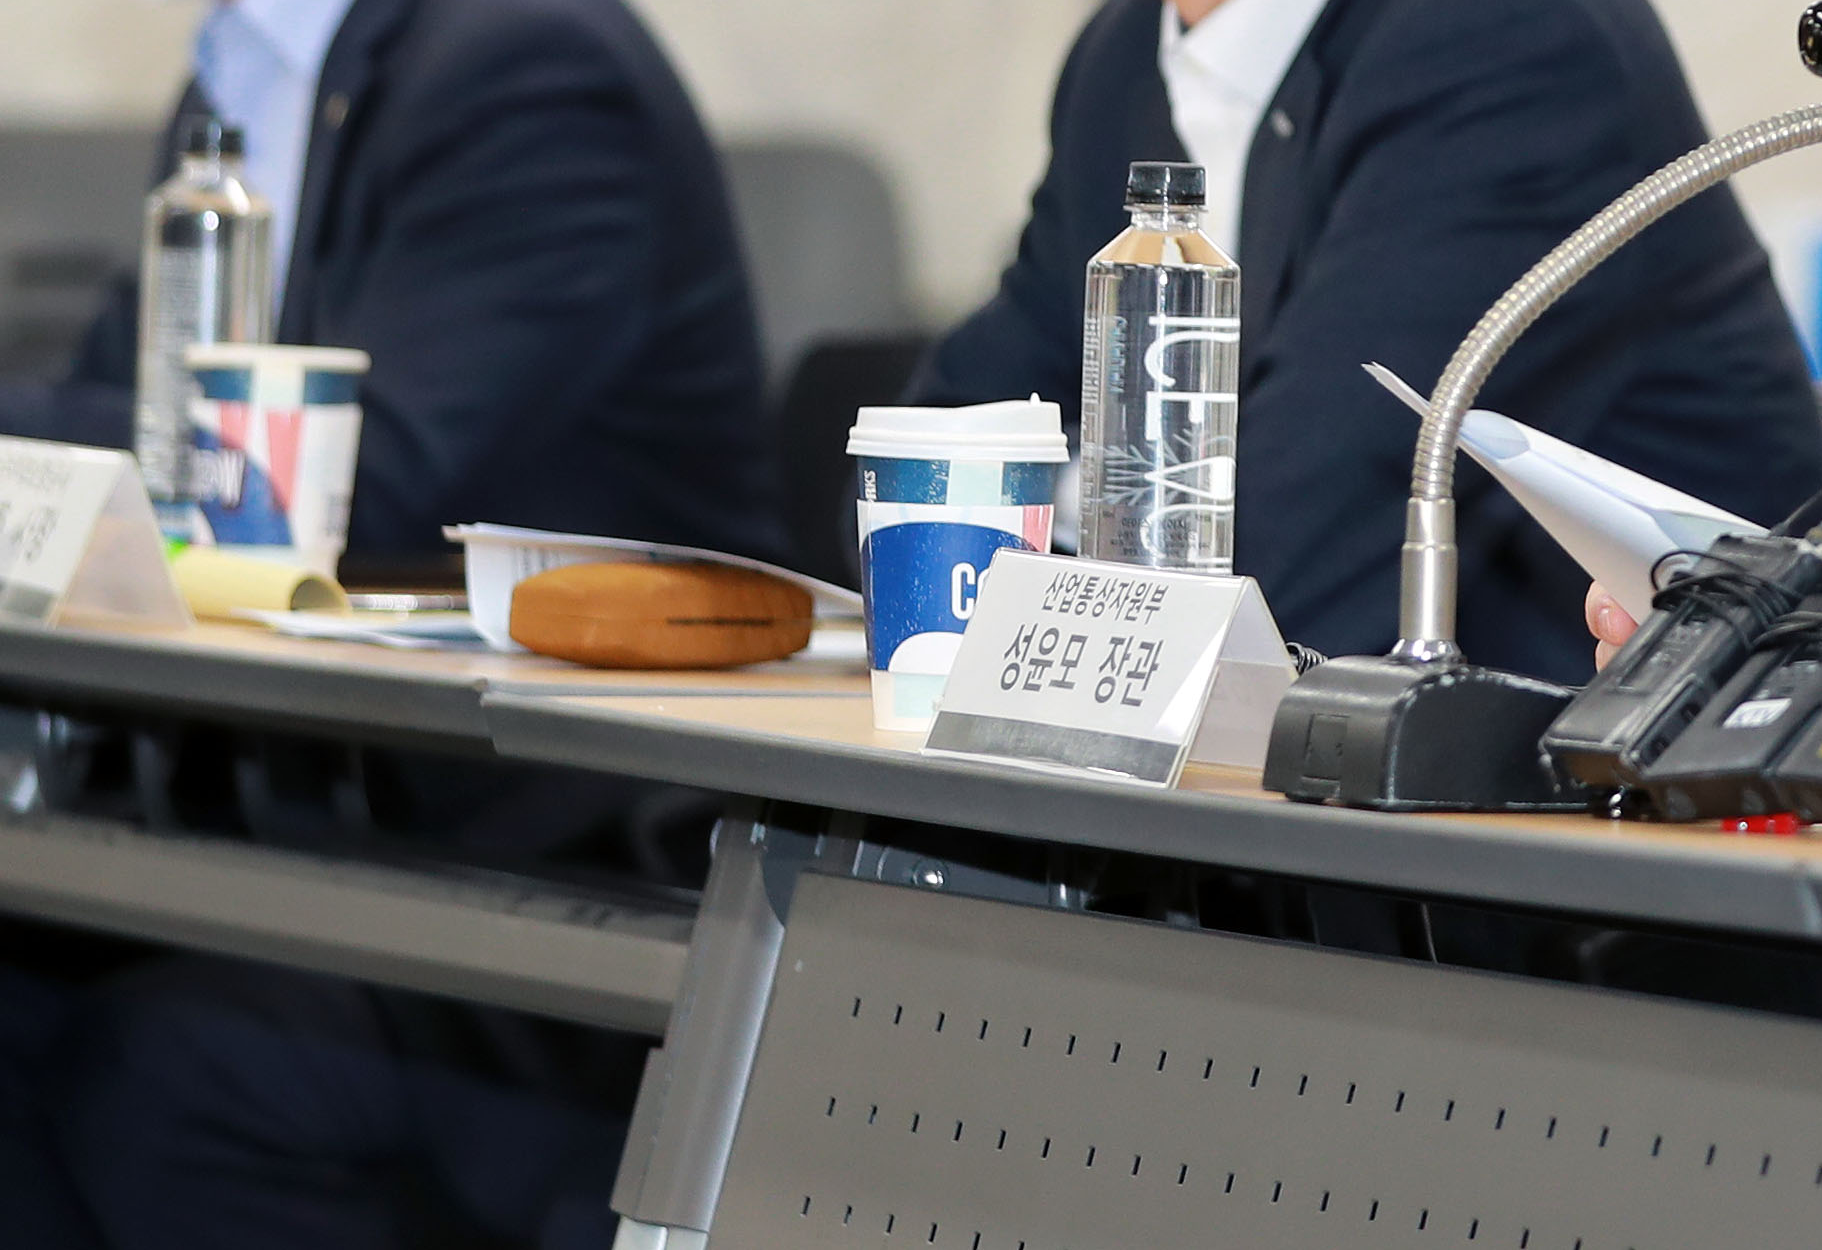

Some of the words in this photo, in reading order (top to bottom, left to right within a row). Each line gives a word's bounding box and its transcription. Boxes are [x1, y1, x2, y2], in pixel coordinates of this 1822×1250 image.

[1042, 571, 1169, 625] 산업통상자원부
[1000, 623, 1089, 691] 성윤모
[1094, 635, 1164, 707] 장관
